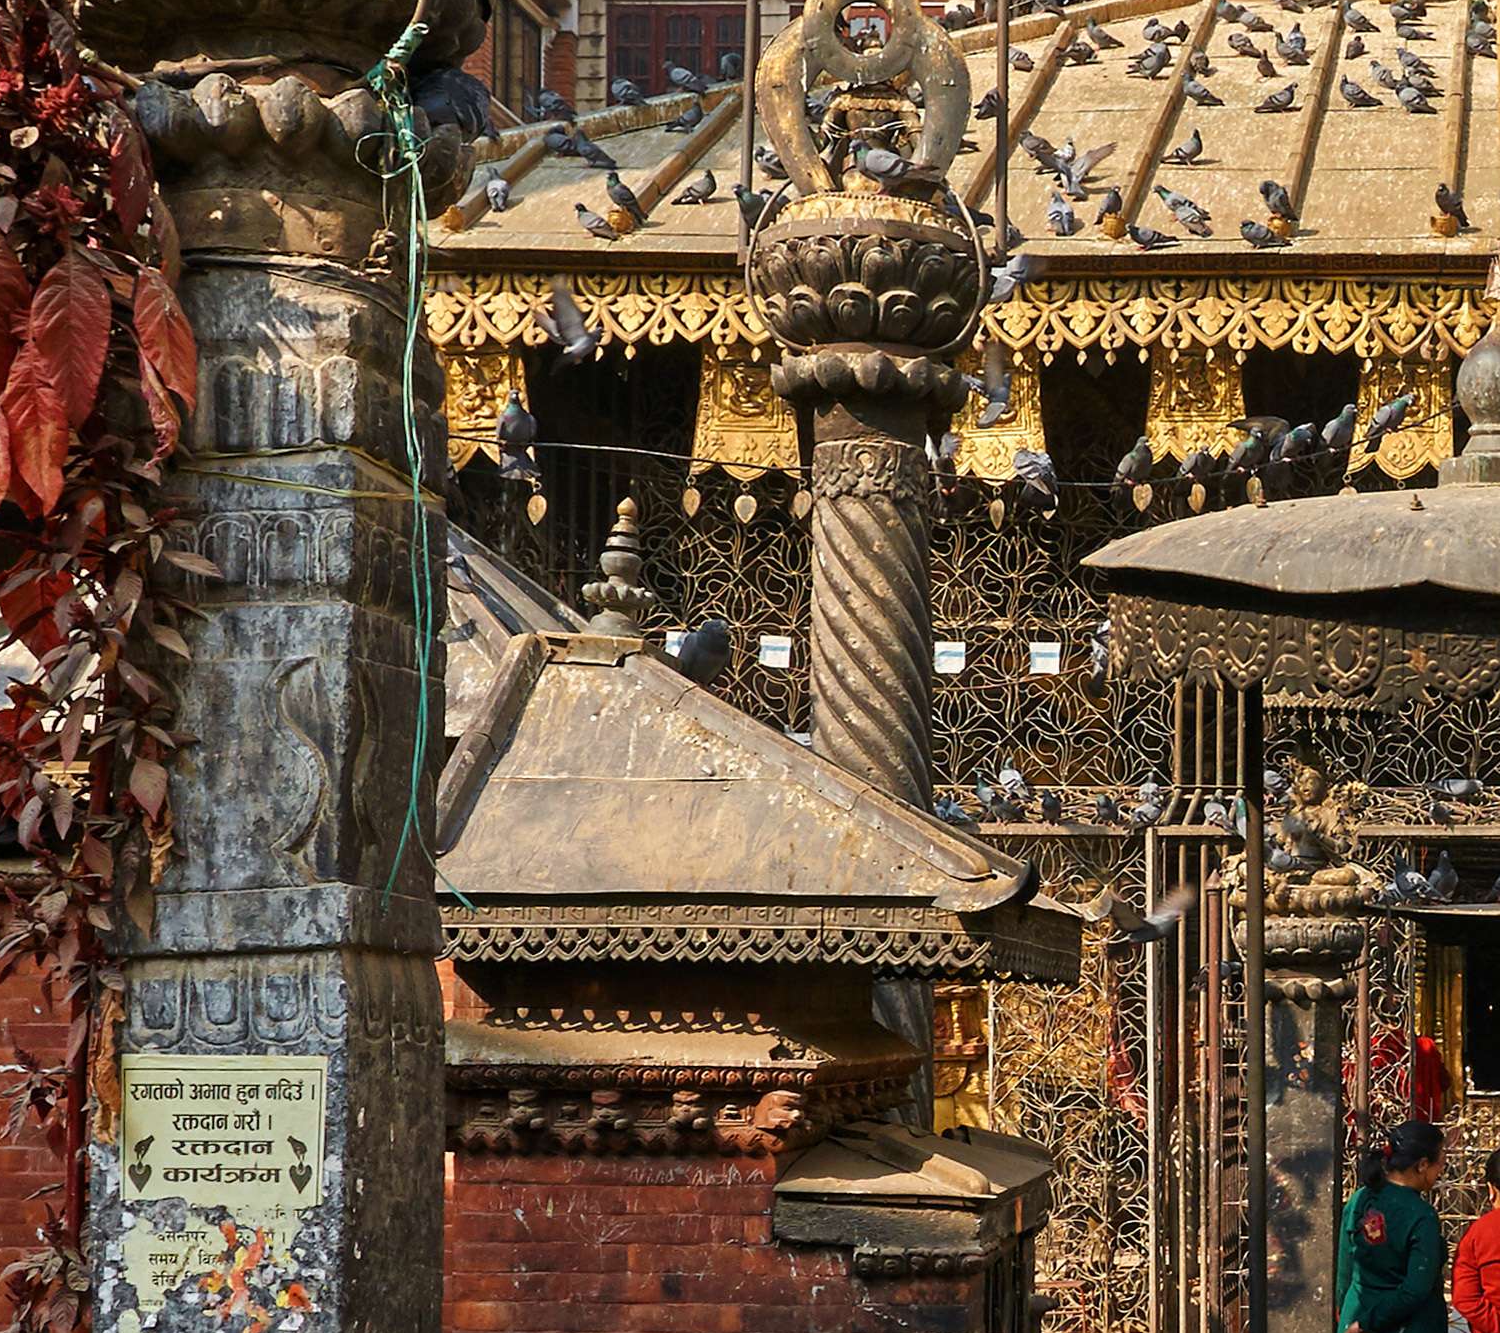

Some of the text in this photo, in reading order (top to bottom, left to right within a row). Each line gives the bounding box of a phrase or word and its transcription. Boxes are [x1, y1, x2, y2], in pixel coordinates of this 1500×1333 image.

[131, 1078, 184, 1100] रगतको
[189, 1084, 232, 1100] अभाव
[236, 1084, 260, 1105] हुन
[172, 1114, 229, 1131] रक्तदान
[172, 1140, 274, 1156] रक्तदान
[163, 1162, 282, 1183] कार्यक्रम
[149, 1254, 179, 1265] समय
